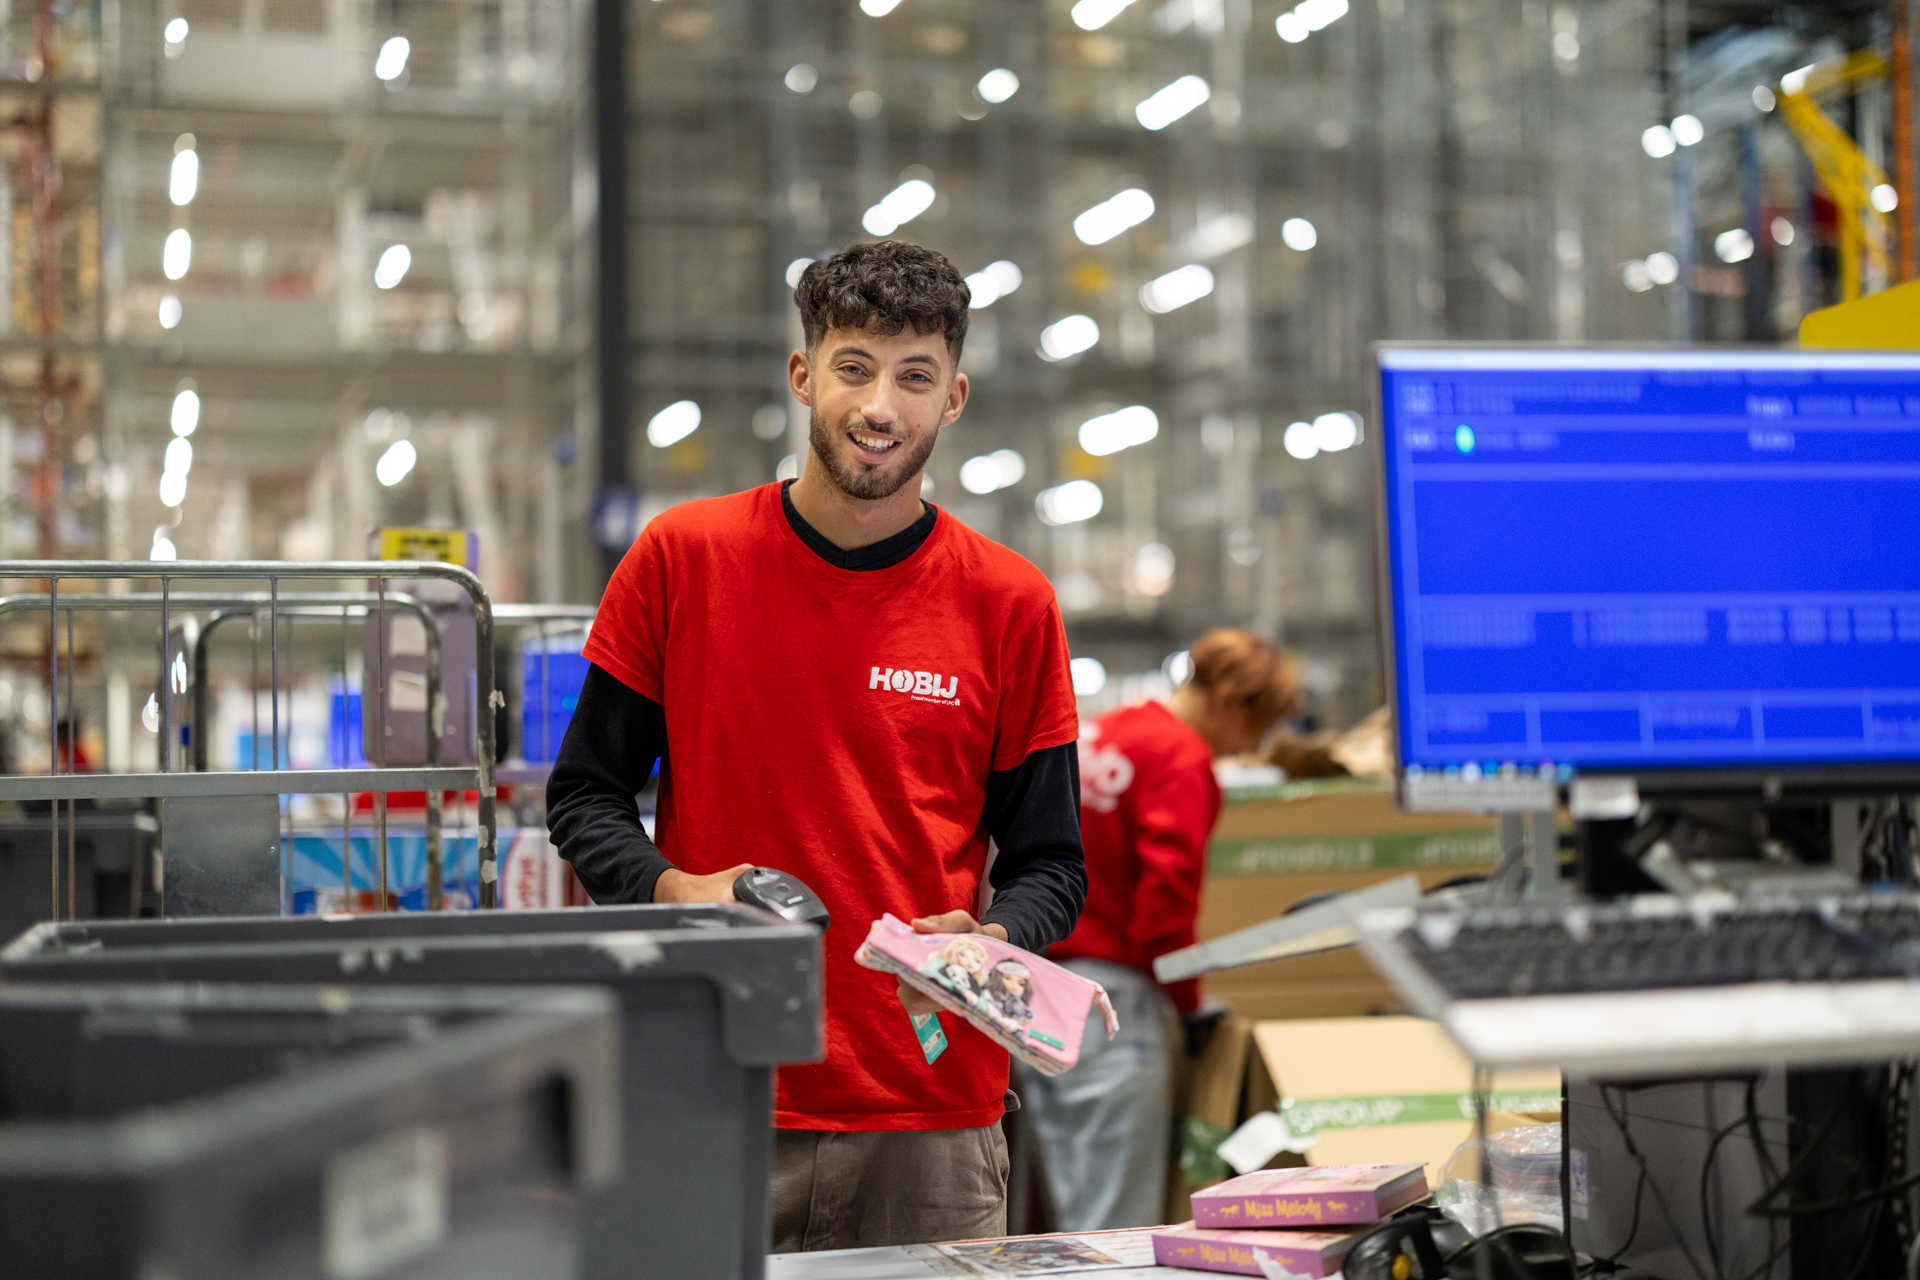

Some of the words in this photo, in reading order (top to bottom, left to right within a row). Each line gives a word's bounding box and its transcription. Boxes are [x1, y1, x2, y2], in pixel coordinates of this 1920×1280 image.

[869, 666, 959, 699] HOBIJ
[1244, 1200, 1274, 1219] Miss
[1275, 1197, 1321, 1220] Melody
[1199, 1243, 1226, 1263] Miss
[1228, 1246, 1257, 1267] Melo
